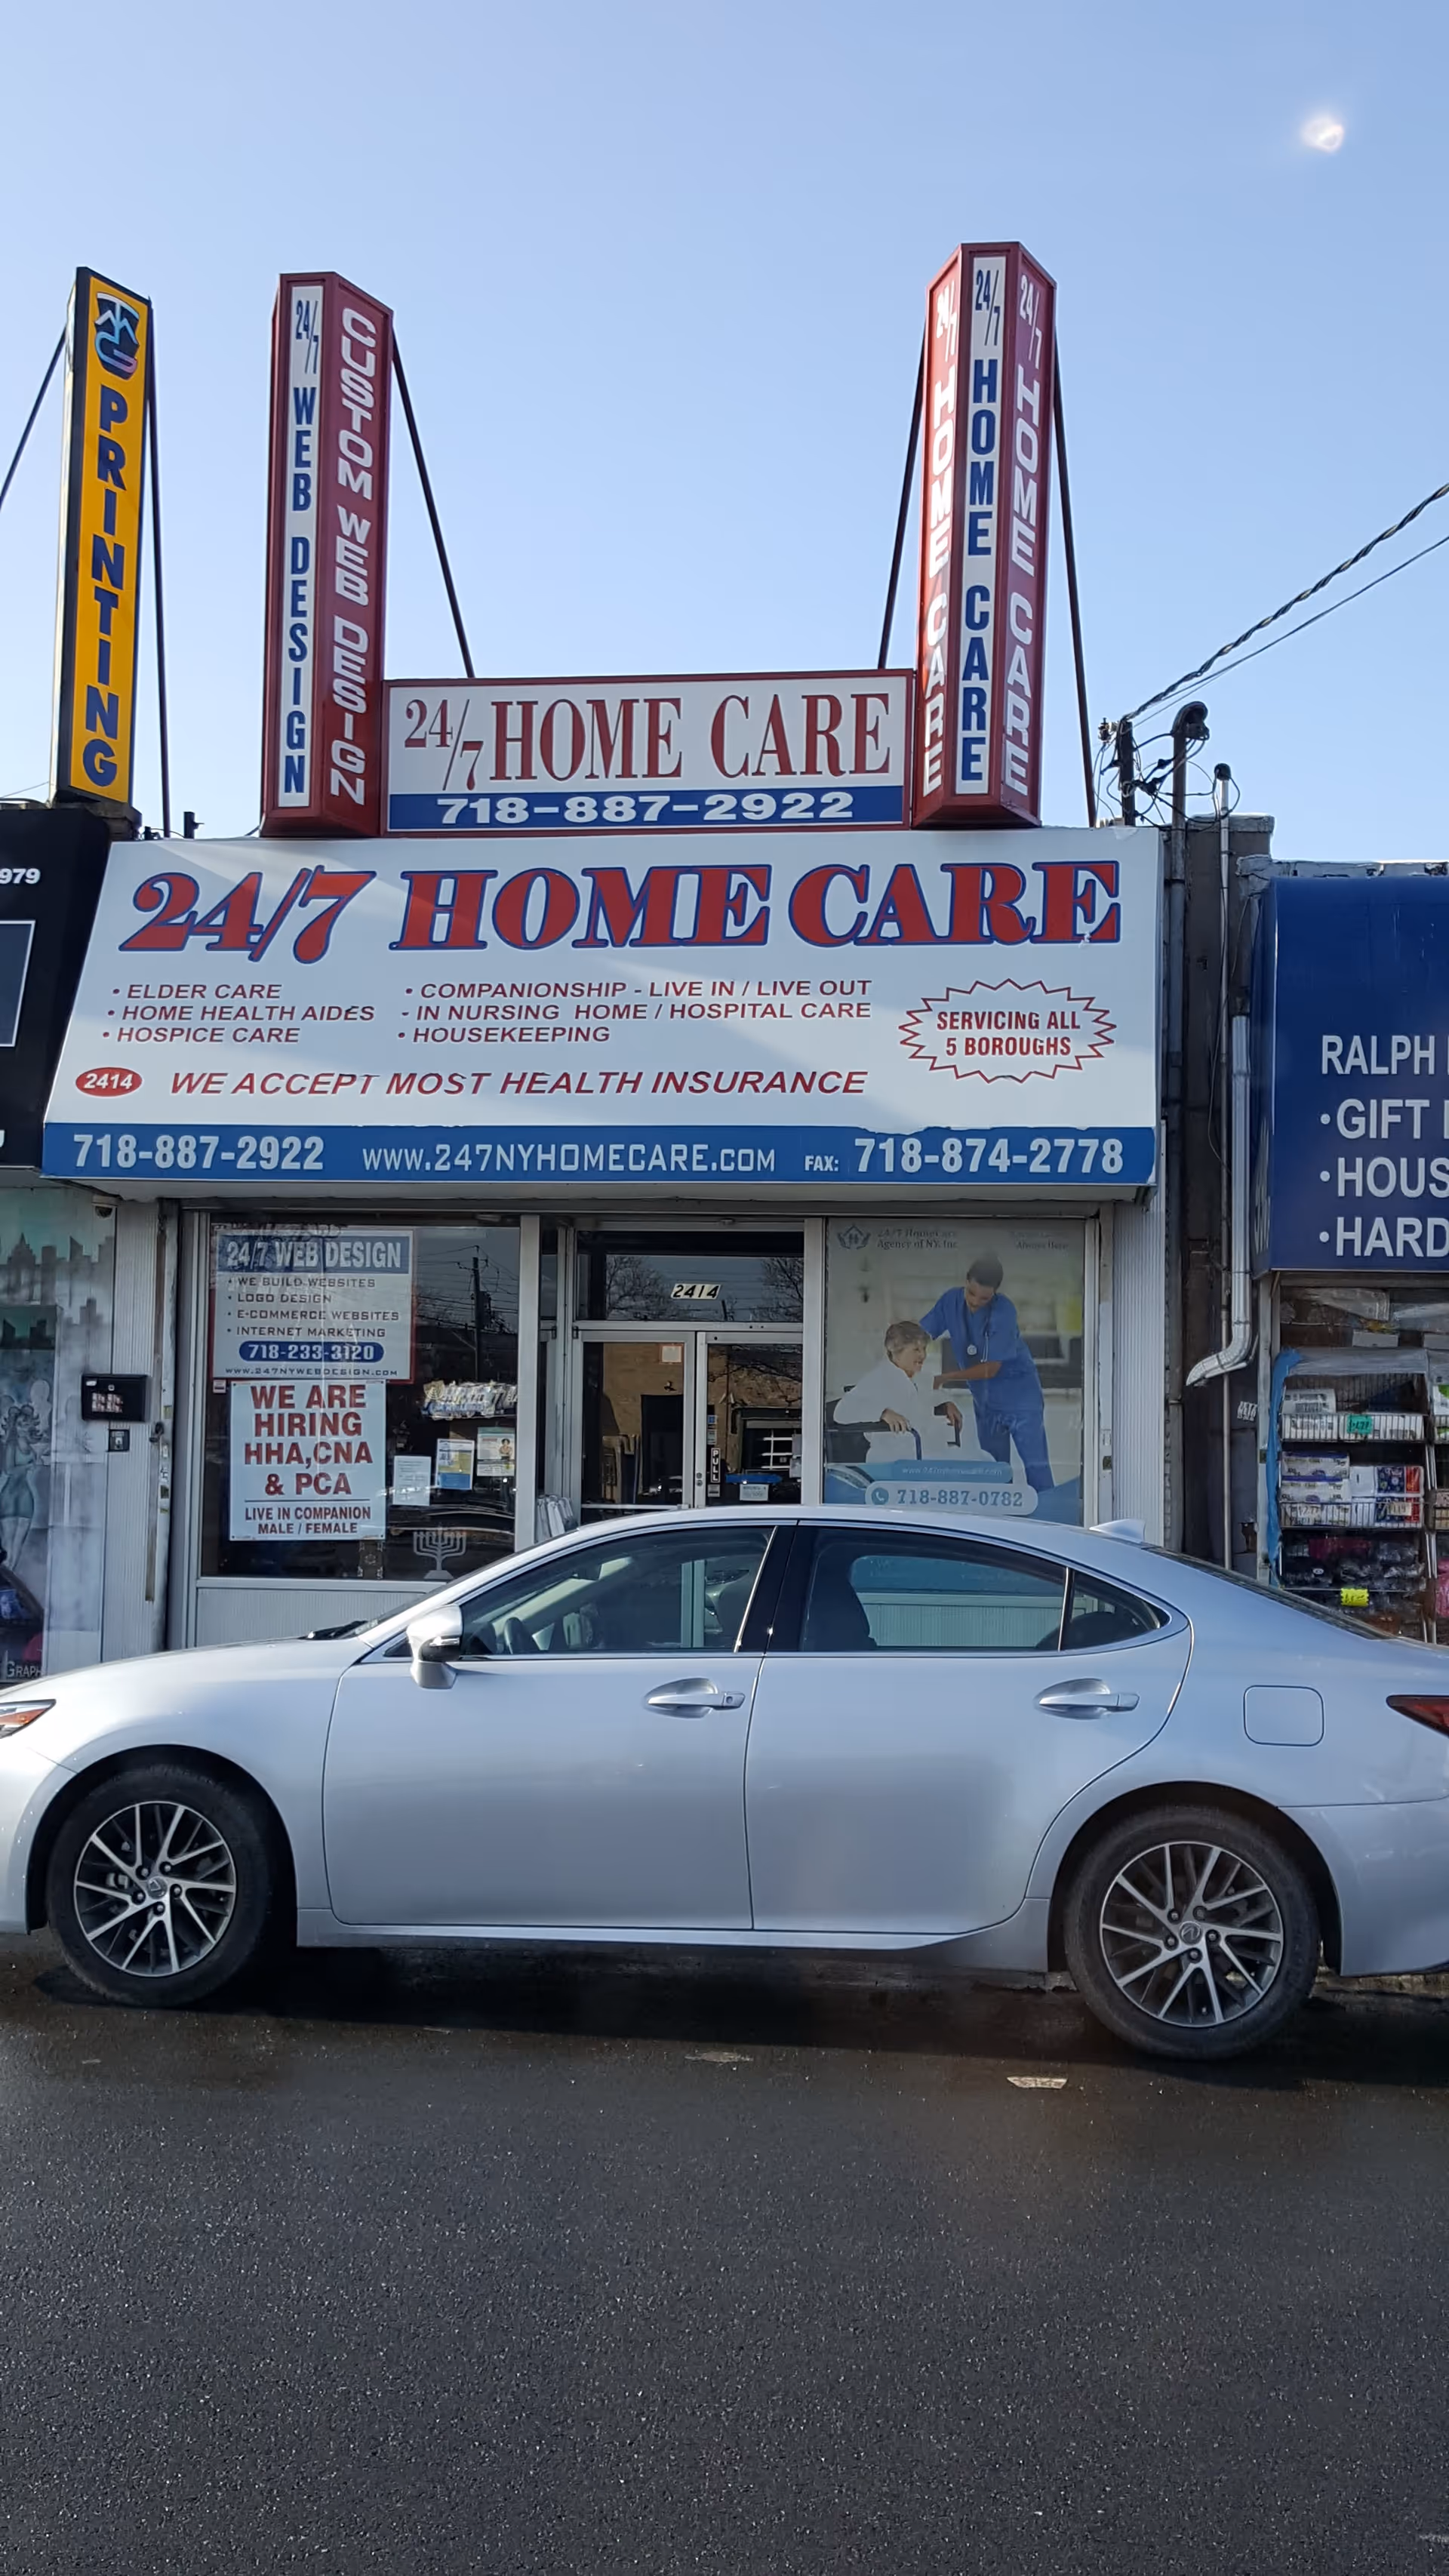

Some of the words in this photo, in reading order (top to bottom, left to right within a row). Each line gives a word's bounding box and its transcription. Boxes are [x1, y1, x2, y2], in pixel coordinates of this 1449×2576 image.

[975, 269, 1000, 346] 24/7
[1020, 275, 1042, 364] 24/7
[296, 300, 318, 375] 24/7
[338, 307, 377, 500] CUSTOM
[293, 387, 316, 512] WEB
[968, 359, 997, 556] HOME
[929, 365, 955, 579] HOME
[1012, 364, 1040, 577] HOME
[335, 505, 370, 606] WEB
[83, 386, 128, 786] PRINTING
[284, 537, 310, 792] DESIGN
[923, 592, 948, 797] CARE
[961, 585, 990, 780] CARE
[1005, 591, 1034, 796] CARE
[330, 615, 369, 805] DESIGN
[405, 698, 484, 792] 24/7
[490, 697, 681, 782] HOME
[711, 693, 890, 778] CARE
[436, 791, 854, 824] 718-887-2922
[118, 864, 377, 965] 24/7
[389, 865, 771, 951] HOME
[789, 860, 1121, 948] CARE
[127, 983, 207, 999] ELDER
[214, 983, 282, 999] CARE
[420, 982, 627, 999] COMPANIONSHIP
[648, 981, 703, 997] LIVE
[711, 981, 735, 996] IN
[756, 980, 811, 996] LIVE
[819, 980, 872, 996] OUT
[122, 1005, 193, 1021] HOME
[200, 1005, 296, 1021] HEALTH
[300, 1005, 375, 1021] AIDES
[416, 1005, 440, 1020] IN
[448, 1005, 560, 1020] NURSING
[574, 1004, 648, 1020] HOME
[669, 1003, 792, 1019] HOSPITAL
[800, 1002, 872, 1019] CARE
[937, 1011, 1040, 1030] SERVICING
[1046, 1011, 1081, 1030] ALL
[116, 1027, 224, 1043] HOSPICE
[232, 1027, 300, 1043] CARE
[413, 1026, 611, 1043] HOUSEKEEPING
[946, 1037, 957, 1056] 5
[964, 1037, 1071, 1056] BOROUGHS
[1321, 1035, 1435, 1075] RALPH
[84, 1073, 133, 1090] 2414
[171, 1072, 228, 1095] WE
[231, 1072, 380, 1095] ACCEPT
[386, 1072, 492, 1095] MOST
[500, 1072, 644, 1095] HEALTH
[651, 1070, 869, 1094] INSURANCE
[1337, 1099, 1430, 1140] GIFT
[73, 1134, 325, 1170] 718-887-2922
[804, 1156, 839, 1172] FAX:
[855, 1137, 1123, 1174] 718-874-2778
[1336, 1217, 1449, 1257] HARD
[226, 1241, 269, 1270] 24/7
[275, 1242, 319, 1268] WEB
[325, 1242, 401, 1268] DESIGN
[238, 1277, 257, 1286] WE
[261, 1277, 303, 1287] BUILD
[308, 1278, 376, 1288] WEBSITES
[672, 1285, 719, 1298] 2414
[238, 1294, 275, 1303] LOGO
[280, 1294, 331, 1303] DESIGN
[238, 1310, 326, 1320] E-COMMERCE
[332, 1311, 399, 1321] WEBSITES
[236, 1326, 303, 1337] INTERNET
[308, 1327, 386, 1337] MARKETING
[248, 1343, 374, 1360] 718-233-3120
[251, 1386, 296, 1409] WE
[306, 1384, 366, 1408] ARE
[254, 1412, 362, 1436] HIRING
[245, 1441, 374, 1467] HHA,CNA
[265, 1474, 285, 1495] &
[295, 1473, 352, 1495] PCA
[897, 1489, 1023, 1507] 718-887-0782
[245, 1507, 274, 1520] LIVE
[278, 1507, 291, 1520] IN
[294, 1507, 371, 1520] COMPANION
[257, 1523, 294, 1534] MALE
[306, 1523, 358, 1534] FEMALE
